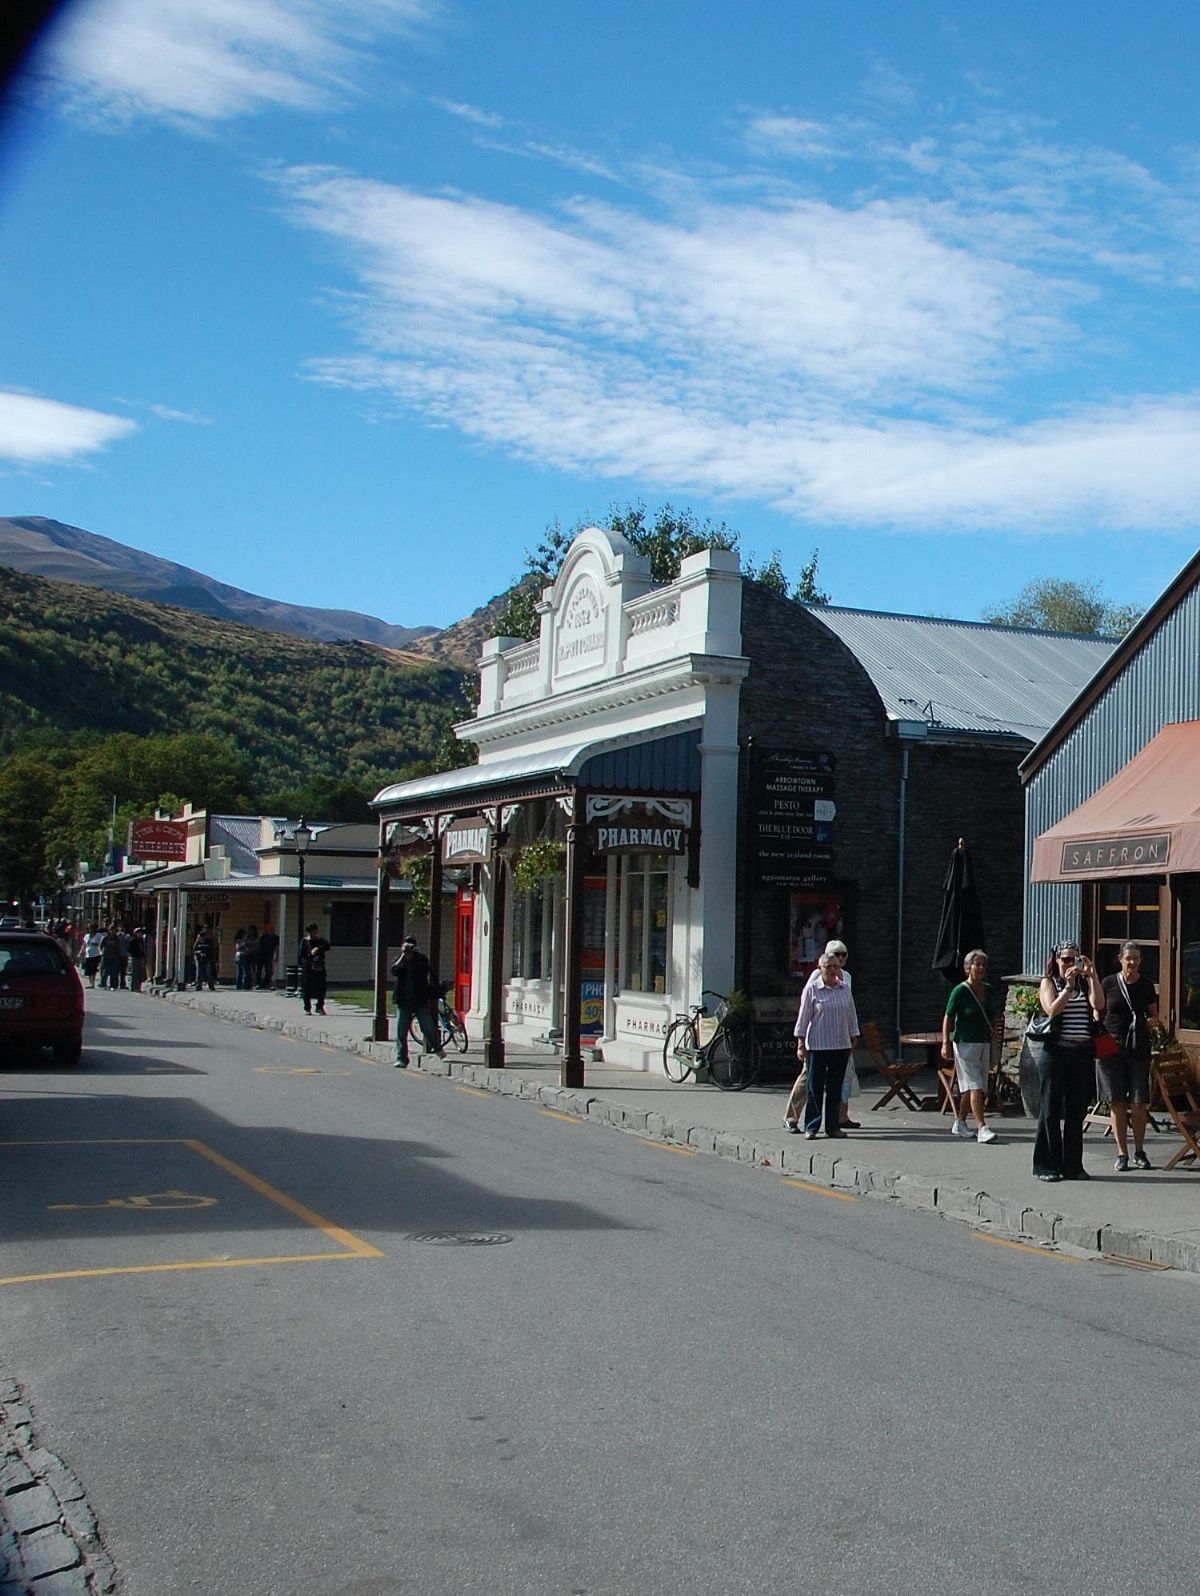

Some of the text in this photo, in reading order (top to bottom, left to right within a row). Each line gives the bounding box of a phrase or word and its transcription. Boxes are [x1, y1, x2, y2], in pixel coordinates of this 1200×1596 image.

[775, 776, 817, 785] ARROWTOWN
[765, 784, 824, 793] MASSAGE THERAPY
[774, 800, 800, 810] PESTO
[446, 827, 488, 859] PHARMACY
[598, 828, 682, 851] PHARMACY
[758, 850, 770, 858] the
[1072, 844, 1159, 865] SAFFRON
[512, 1001, 545, 1015] PHARMACY
[627, 1018, 669, 1034] PHARMAC
